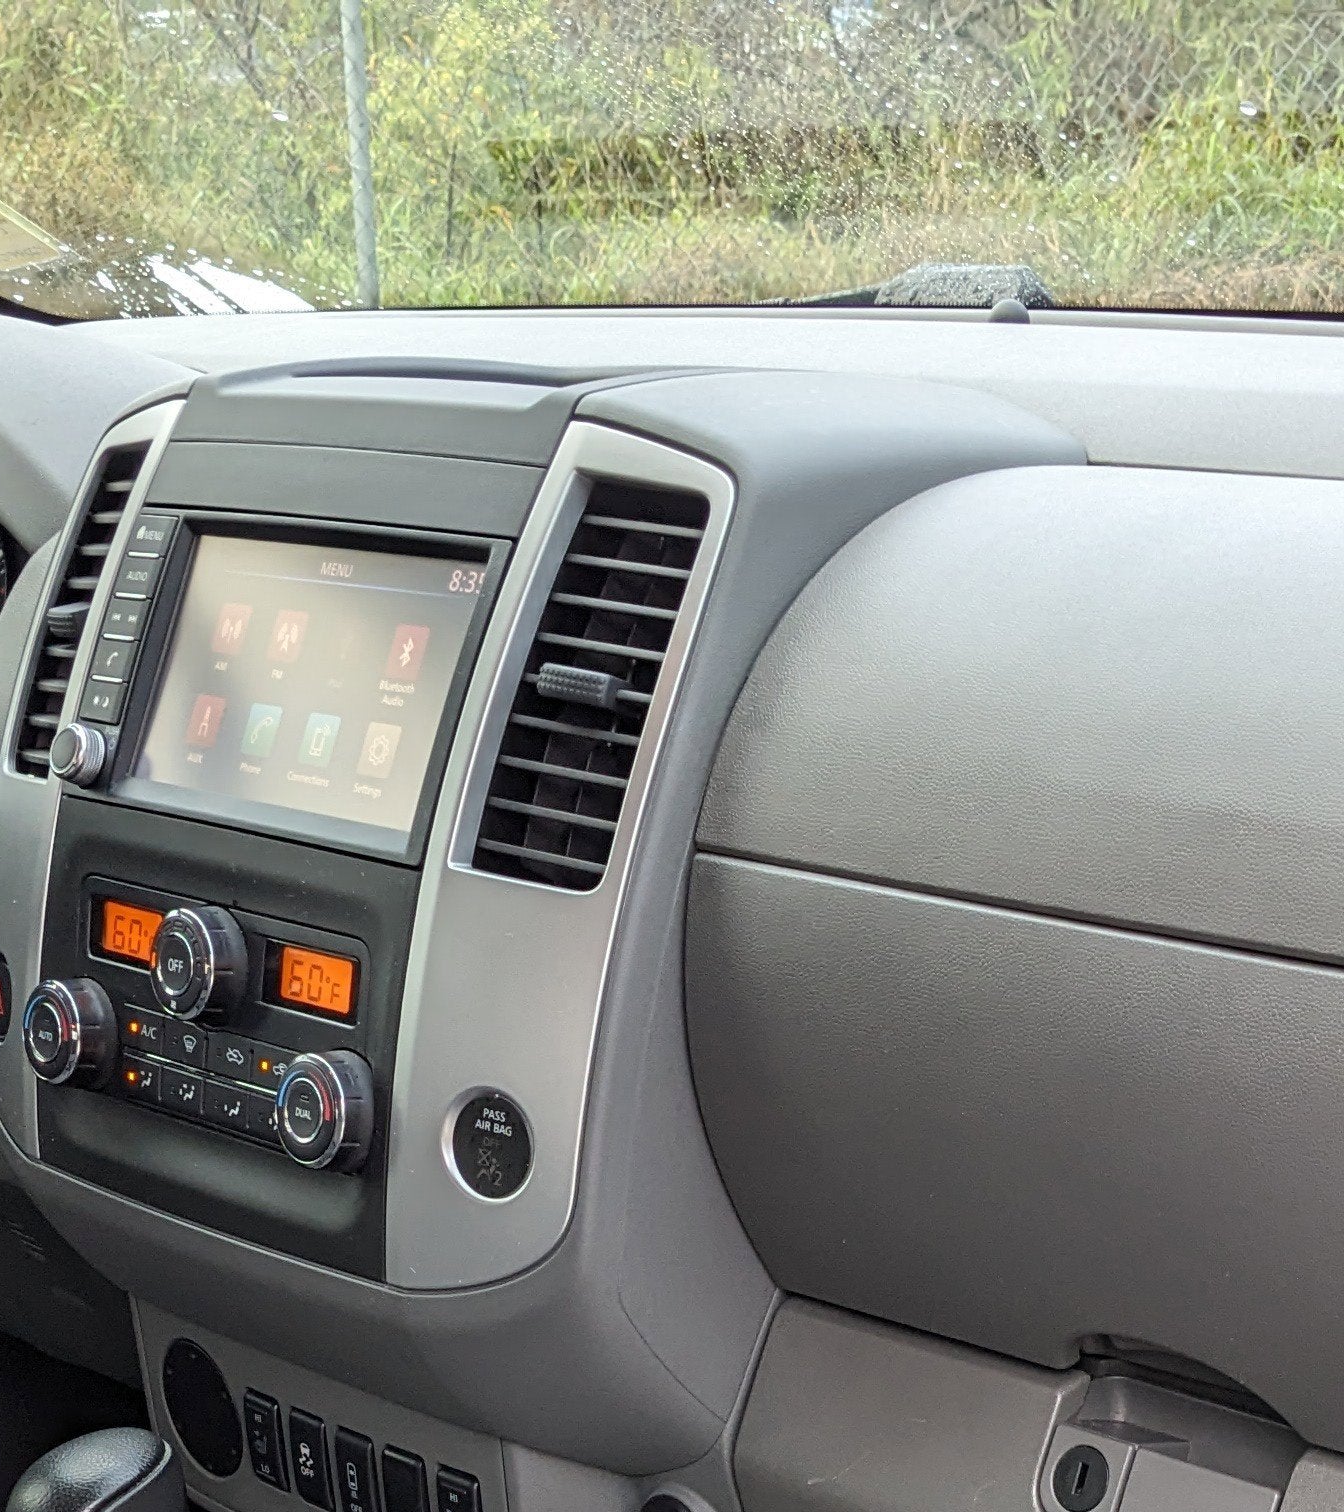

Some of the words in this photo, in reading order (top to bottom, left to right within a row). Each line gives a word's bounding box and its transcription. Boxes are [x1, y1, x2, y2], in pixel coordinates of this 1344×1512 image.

[320, 562, 354, 578] MENU
[378, 680, 415, 694] Bluetooth
[381, 694, 404, 707] Audio
[112, 914, 156, 955] 60°
[167, 957, 184, 974] OFF
[140, 1024, 157, 1040] A/C
[295, 1106, 312, 1121] DUAL
[482, 1107, 506, 1123] PASS
[474, 1118, 491, 1132] AIR
[493, 1123, 513, 1137] BAG
